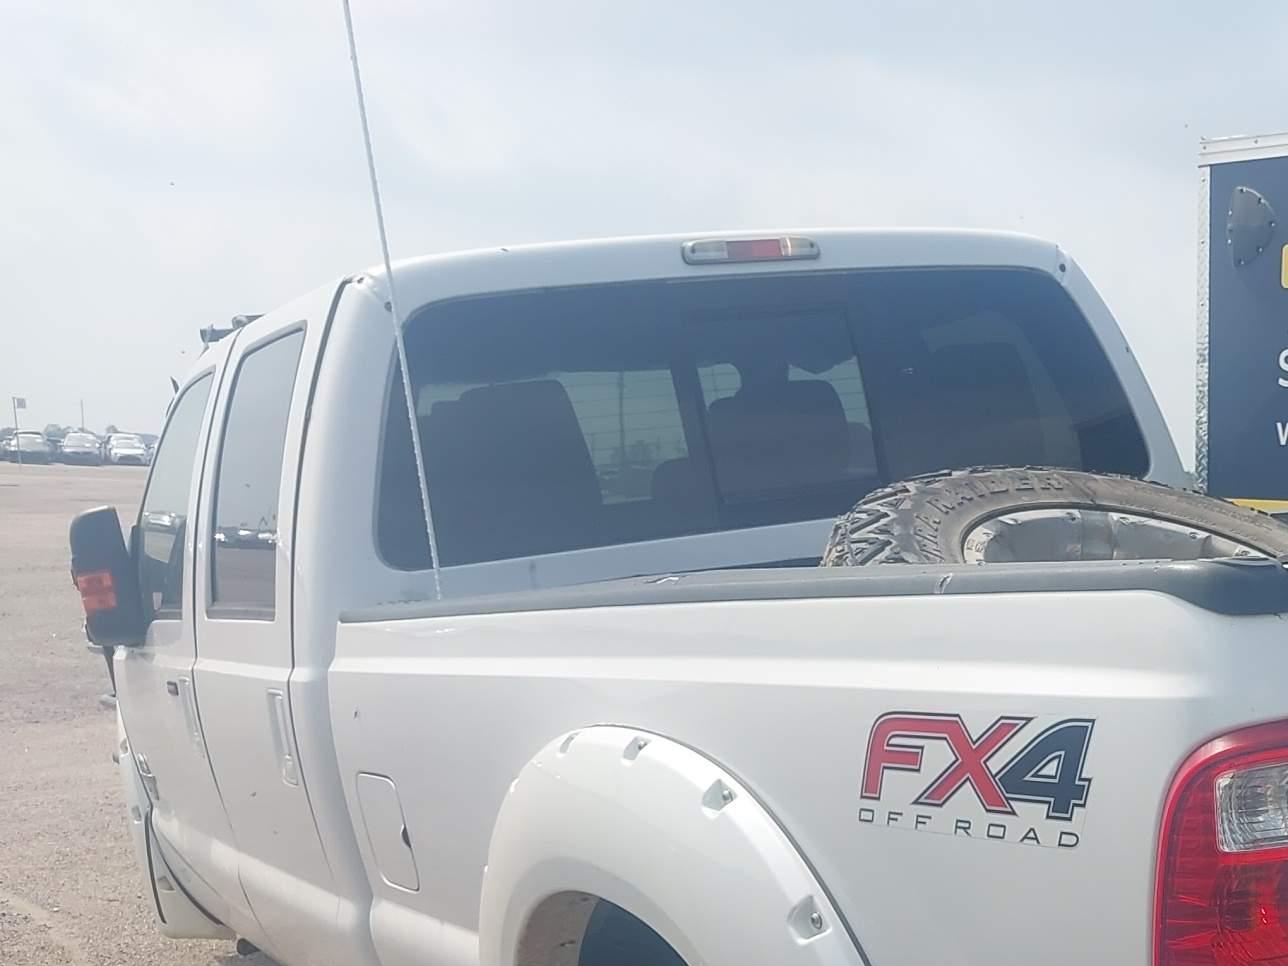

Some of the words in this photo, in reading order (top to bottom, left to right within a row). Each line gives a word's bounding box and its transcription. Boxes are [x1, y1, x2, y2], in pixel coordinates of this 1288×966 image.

[859, 710, 1097, 822] FX4
[857, 807, 933, 830] OFF
[953, 818, 1081, 849] ROAD
